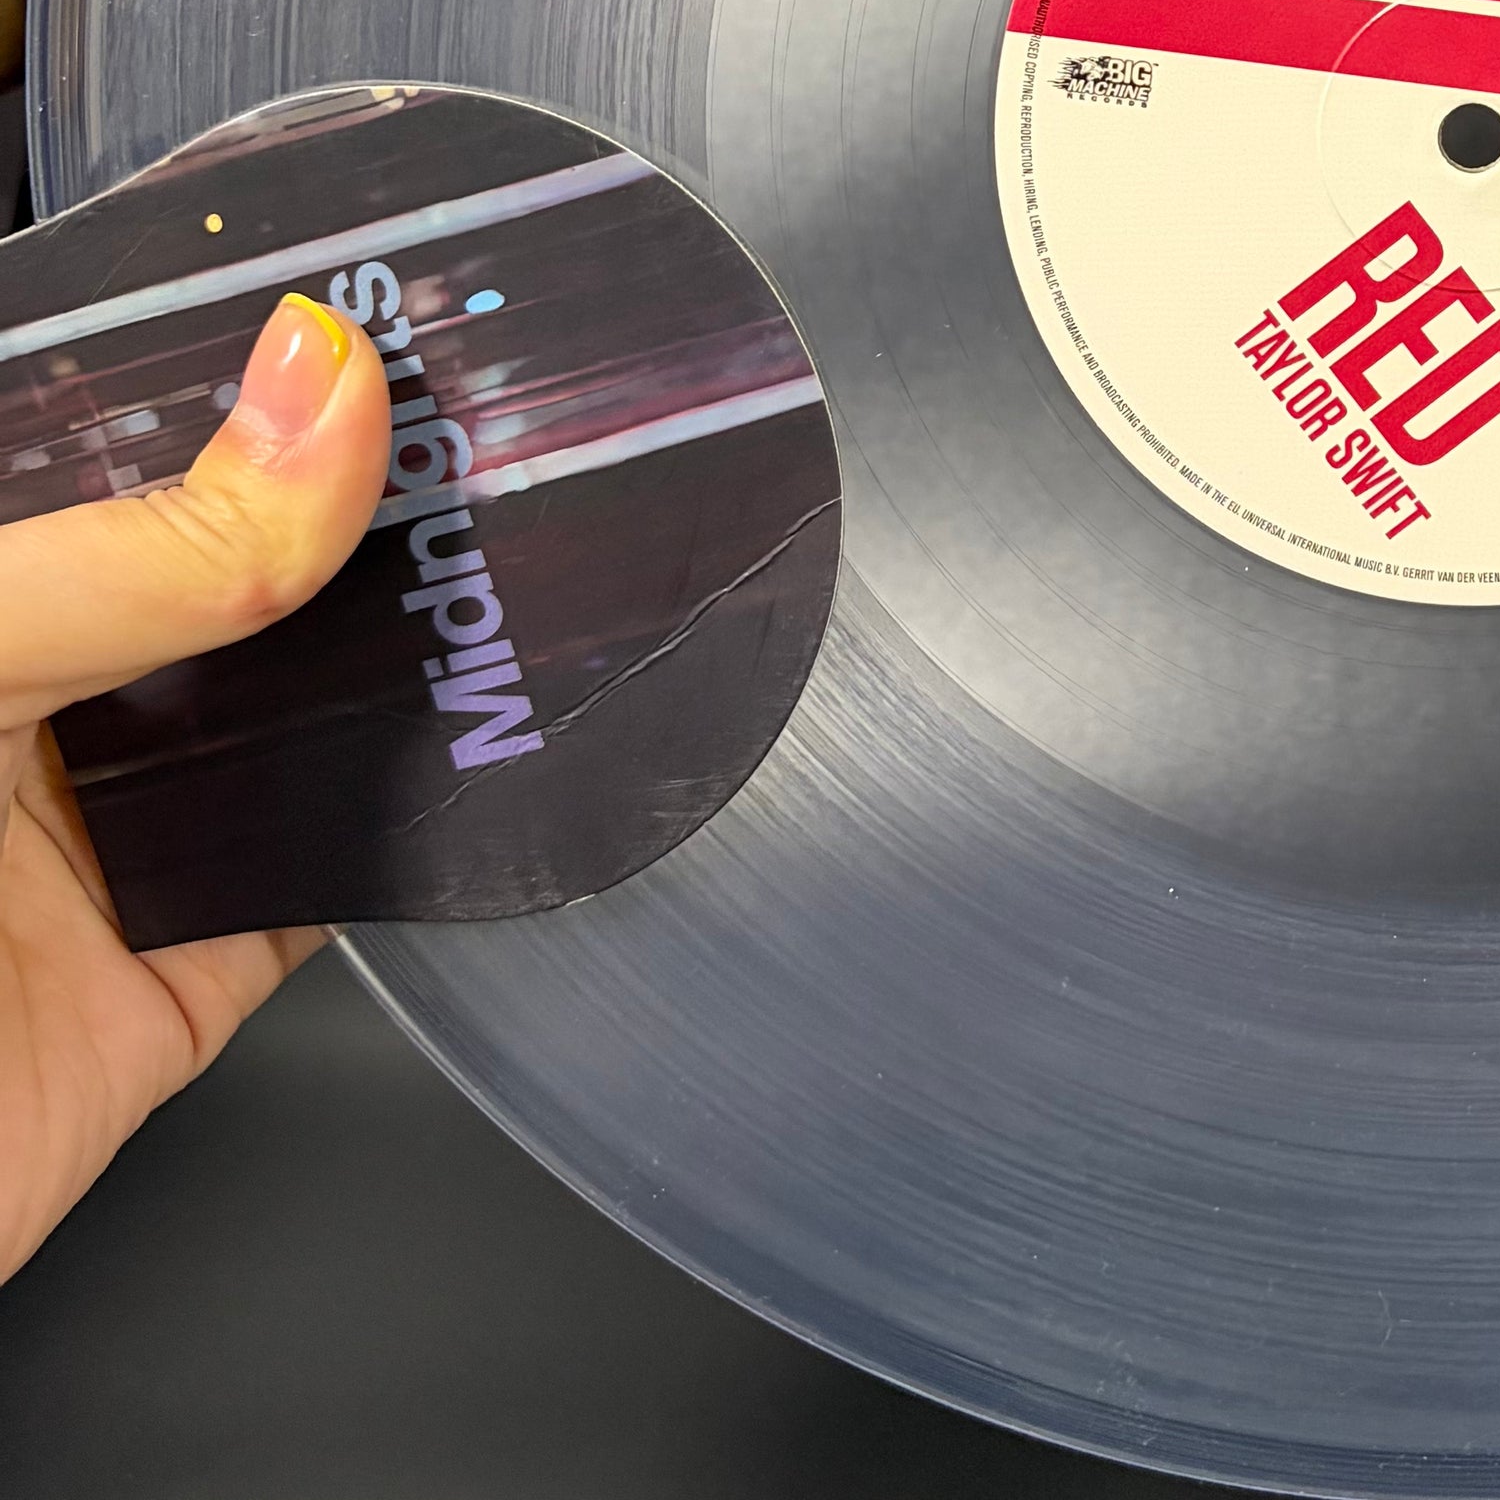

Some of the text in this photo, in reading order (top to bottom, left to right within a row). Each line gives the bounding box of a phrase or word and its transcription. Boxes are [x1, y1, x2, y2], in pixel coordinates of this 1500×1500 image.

[1019, 60, 1037, 103] COPYING,
[1106, 58, 1153, 87] BIG
[1066, 92, 1147, 108] RECORDS
[1067, 78, 1151, 102] MACHINE
[1019, 104, 1034, 177] REPRODUCTION,
[1023, 177, 1039, 214] HIRING,
[1028, 213, 1048, 257] LENDING,
[1039, 256, 1060, 290] PUBLIC
[1051, 288, 1089, 353] PERFORMANCE
[1091, 368, 1141, 428] BROADCASTING
[1234, 309, 1432, 540] TAYLOR SWIFT
[1177, 463, 1204, 488] MADE
[1240, 507, 1286, 541] UNIVERSAL
[1286, 531, 1351, 565] INTERNATIONAL
[1352, 555, 1383, 573] MUSIC
[1383, 562, 1400, 576] B.V.
[1401, 566, 1435, 581] GERRIT
